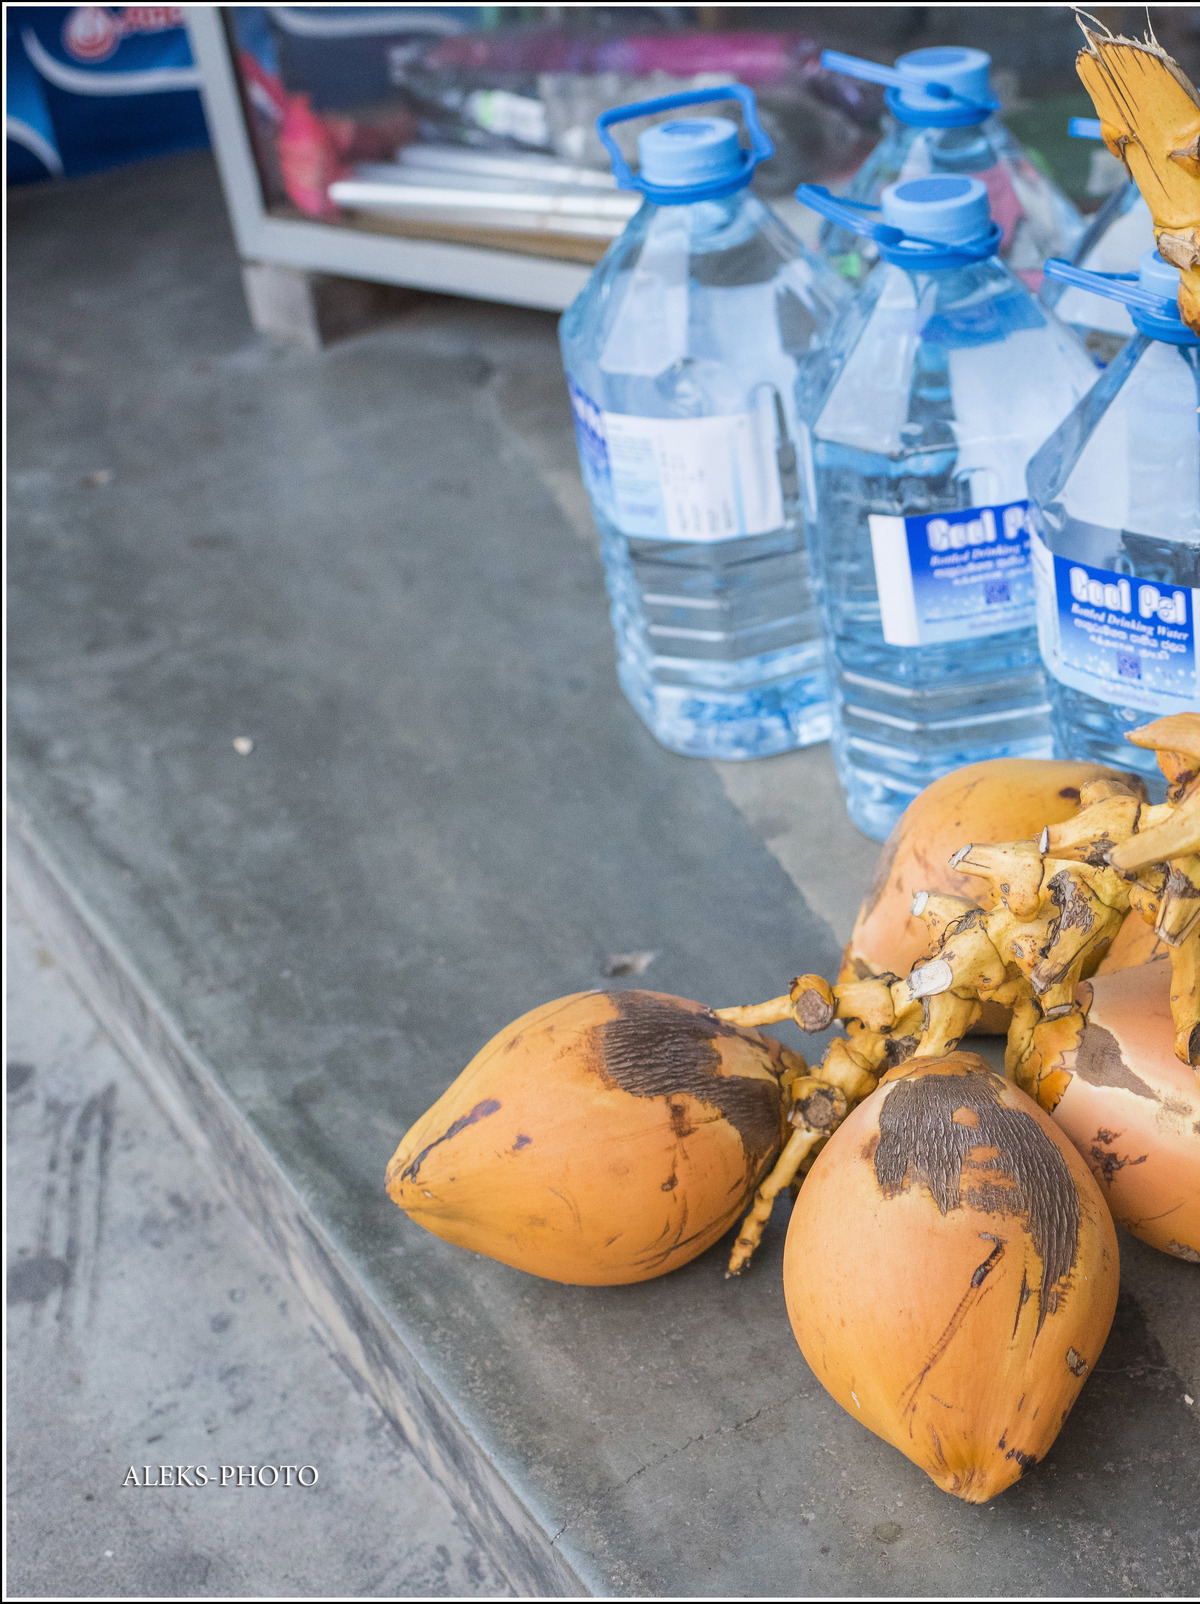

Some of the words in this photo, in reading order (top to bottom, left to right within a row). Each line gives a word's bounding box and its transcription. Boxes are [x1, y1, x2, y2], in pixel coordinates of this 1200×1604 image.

[1069, 566, 1132, 614] Cool
[1138, 584, 1187, 625] Pal
[1107, 613, 1154, 637] Drinking
[1157, 624, 1189, 641] Water
